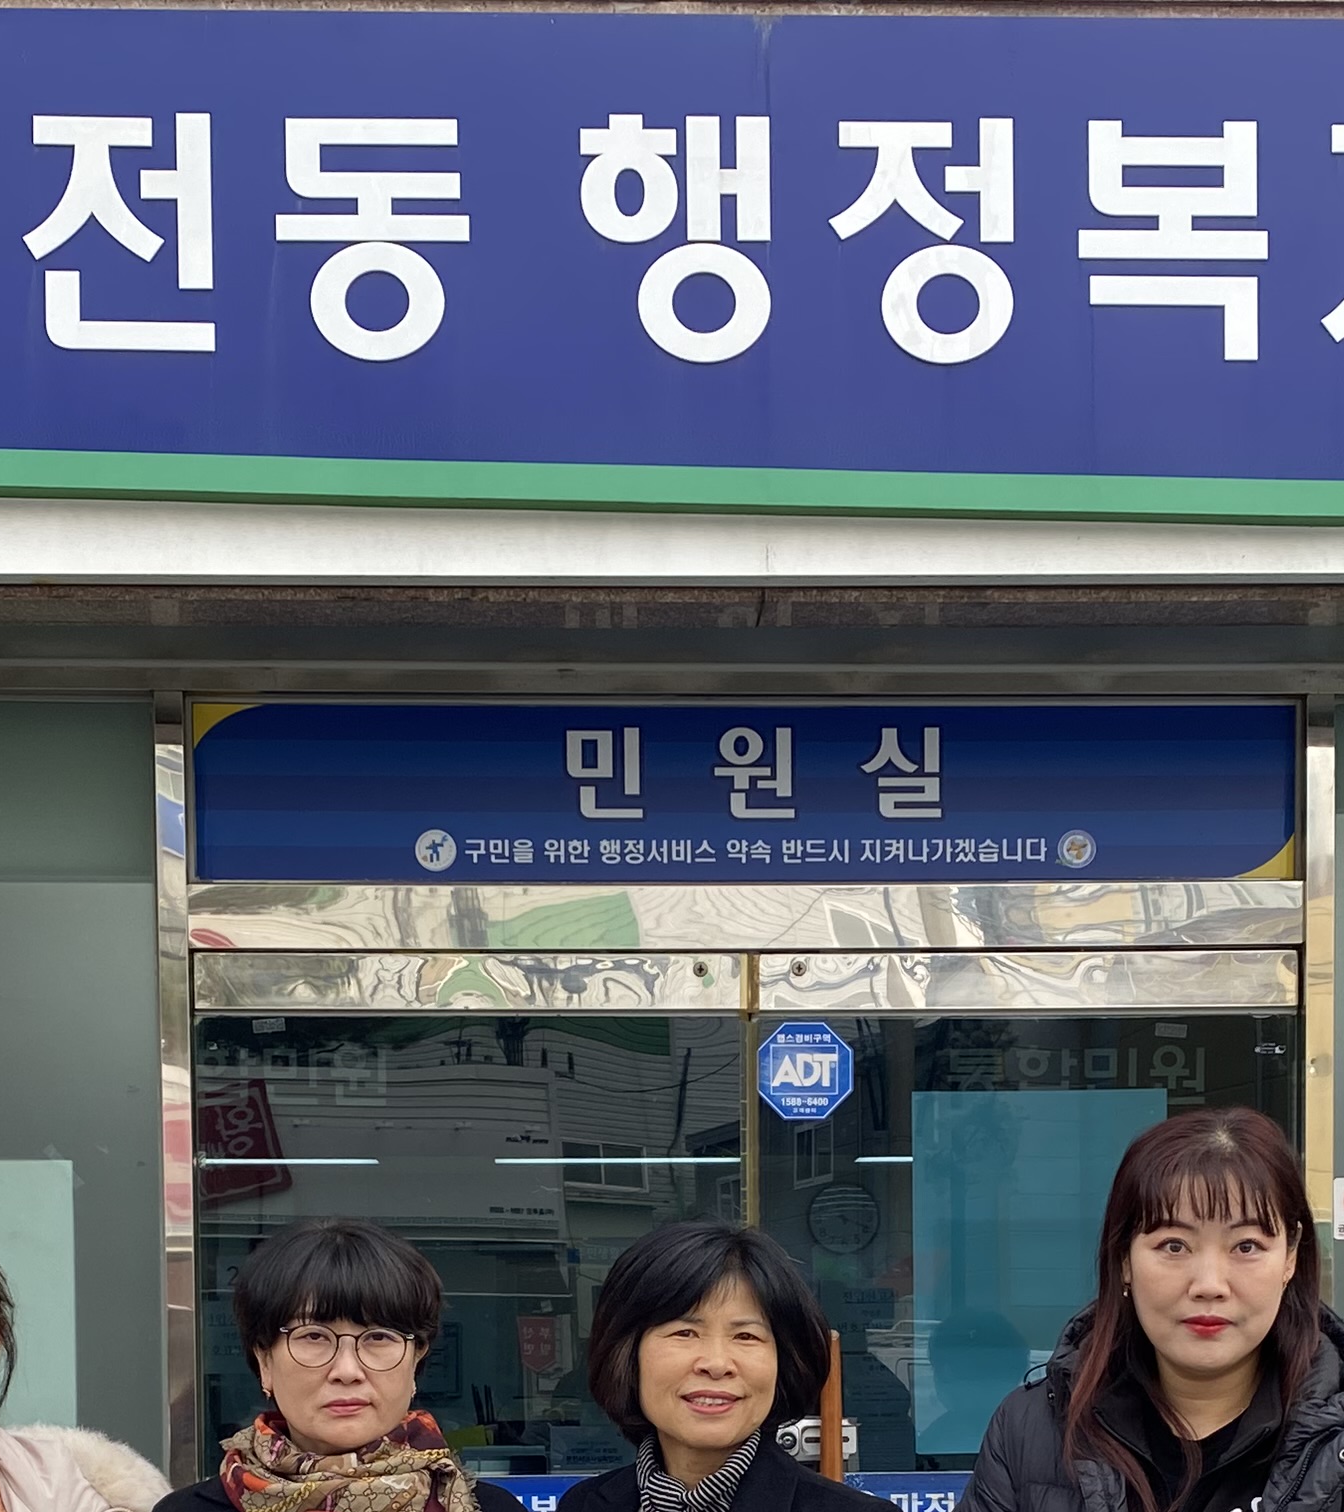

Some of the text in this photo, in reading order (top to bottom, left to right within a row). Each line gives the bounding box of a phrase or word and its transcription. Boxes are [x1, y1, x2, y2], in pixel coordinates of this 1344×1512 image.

[464, 838, 1048, 865] 구민을 위한 행정서비스 약속 반드시 지켜나가겠습니다
[771, 1053, 838, 1087] ADT
